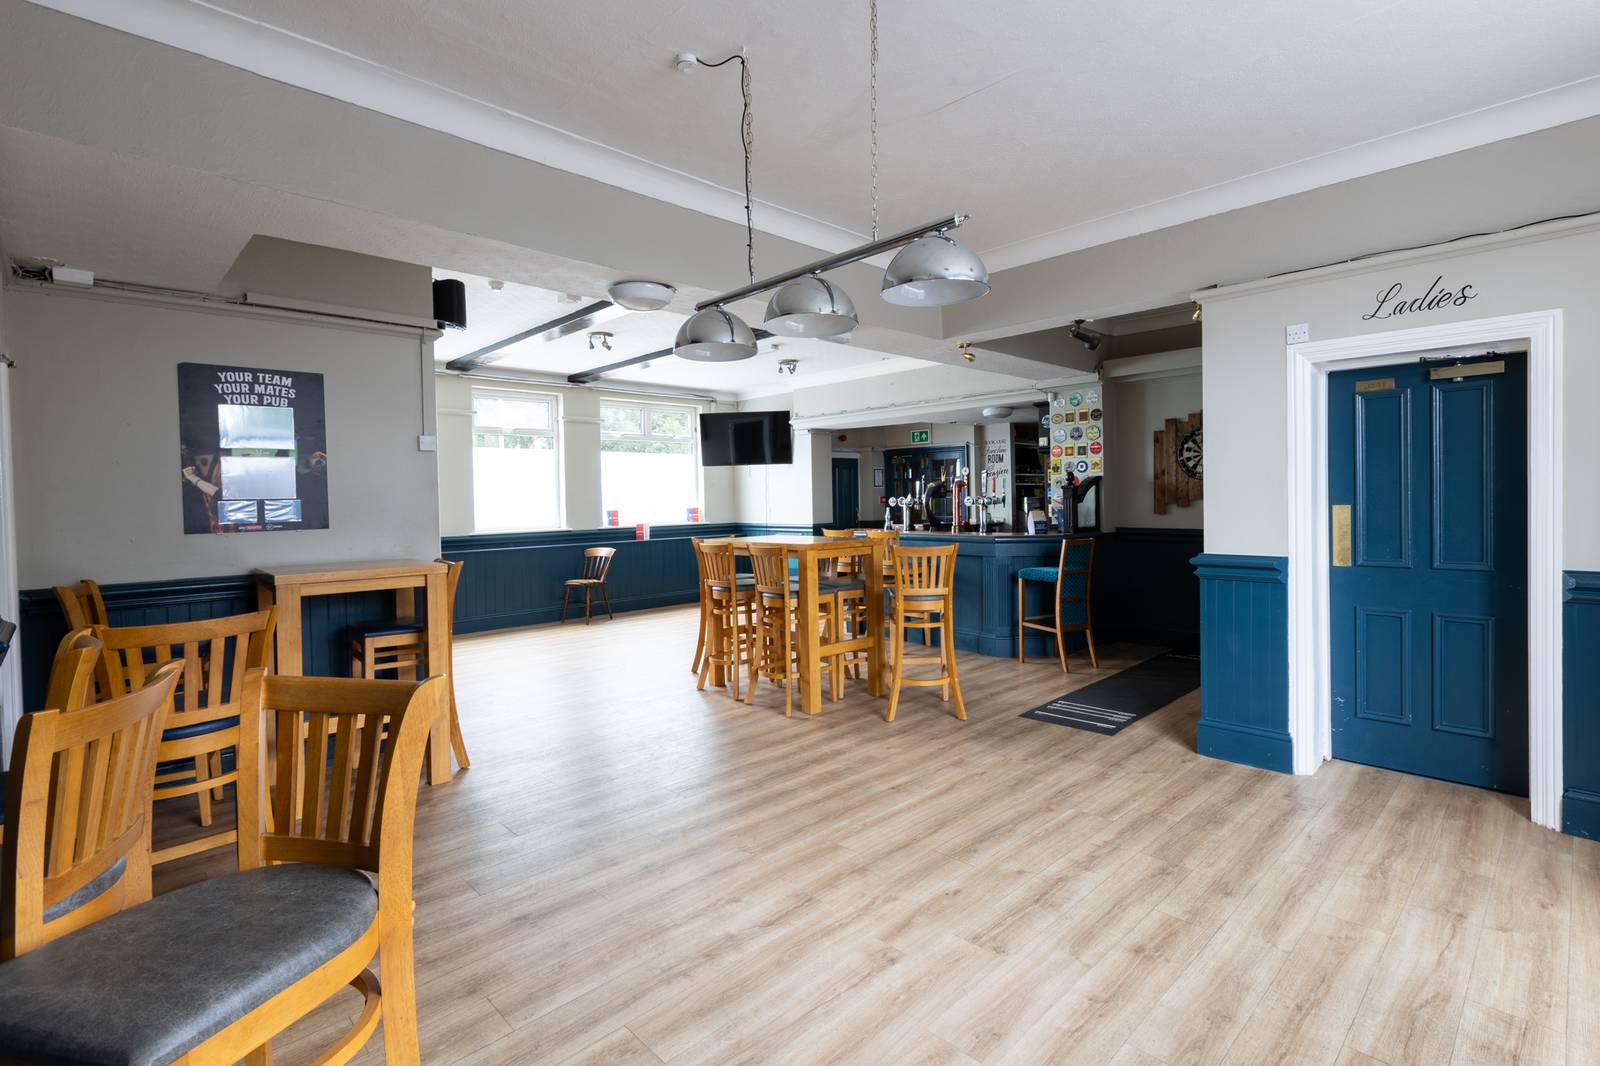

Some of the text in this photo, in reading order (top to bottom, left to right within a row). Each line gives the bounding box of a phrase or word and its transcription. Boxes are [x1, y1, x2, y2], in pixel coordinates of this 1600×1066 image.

[1361, 275, 1478, 321] Ladies
[217, 371, 292, 387] YOUR TEAM
[214, 383, 296, 398] YOUR MATES
[223, 394, 288, 407] YOUR PUB
[987, 454, 1004, 464] ROOM
